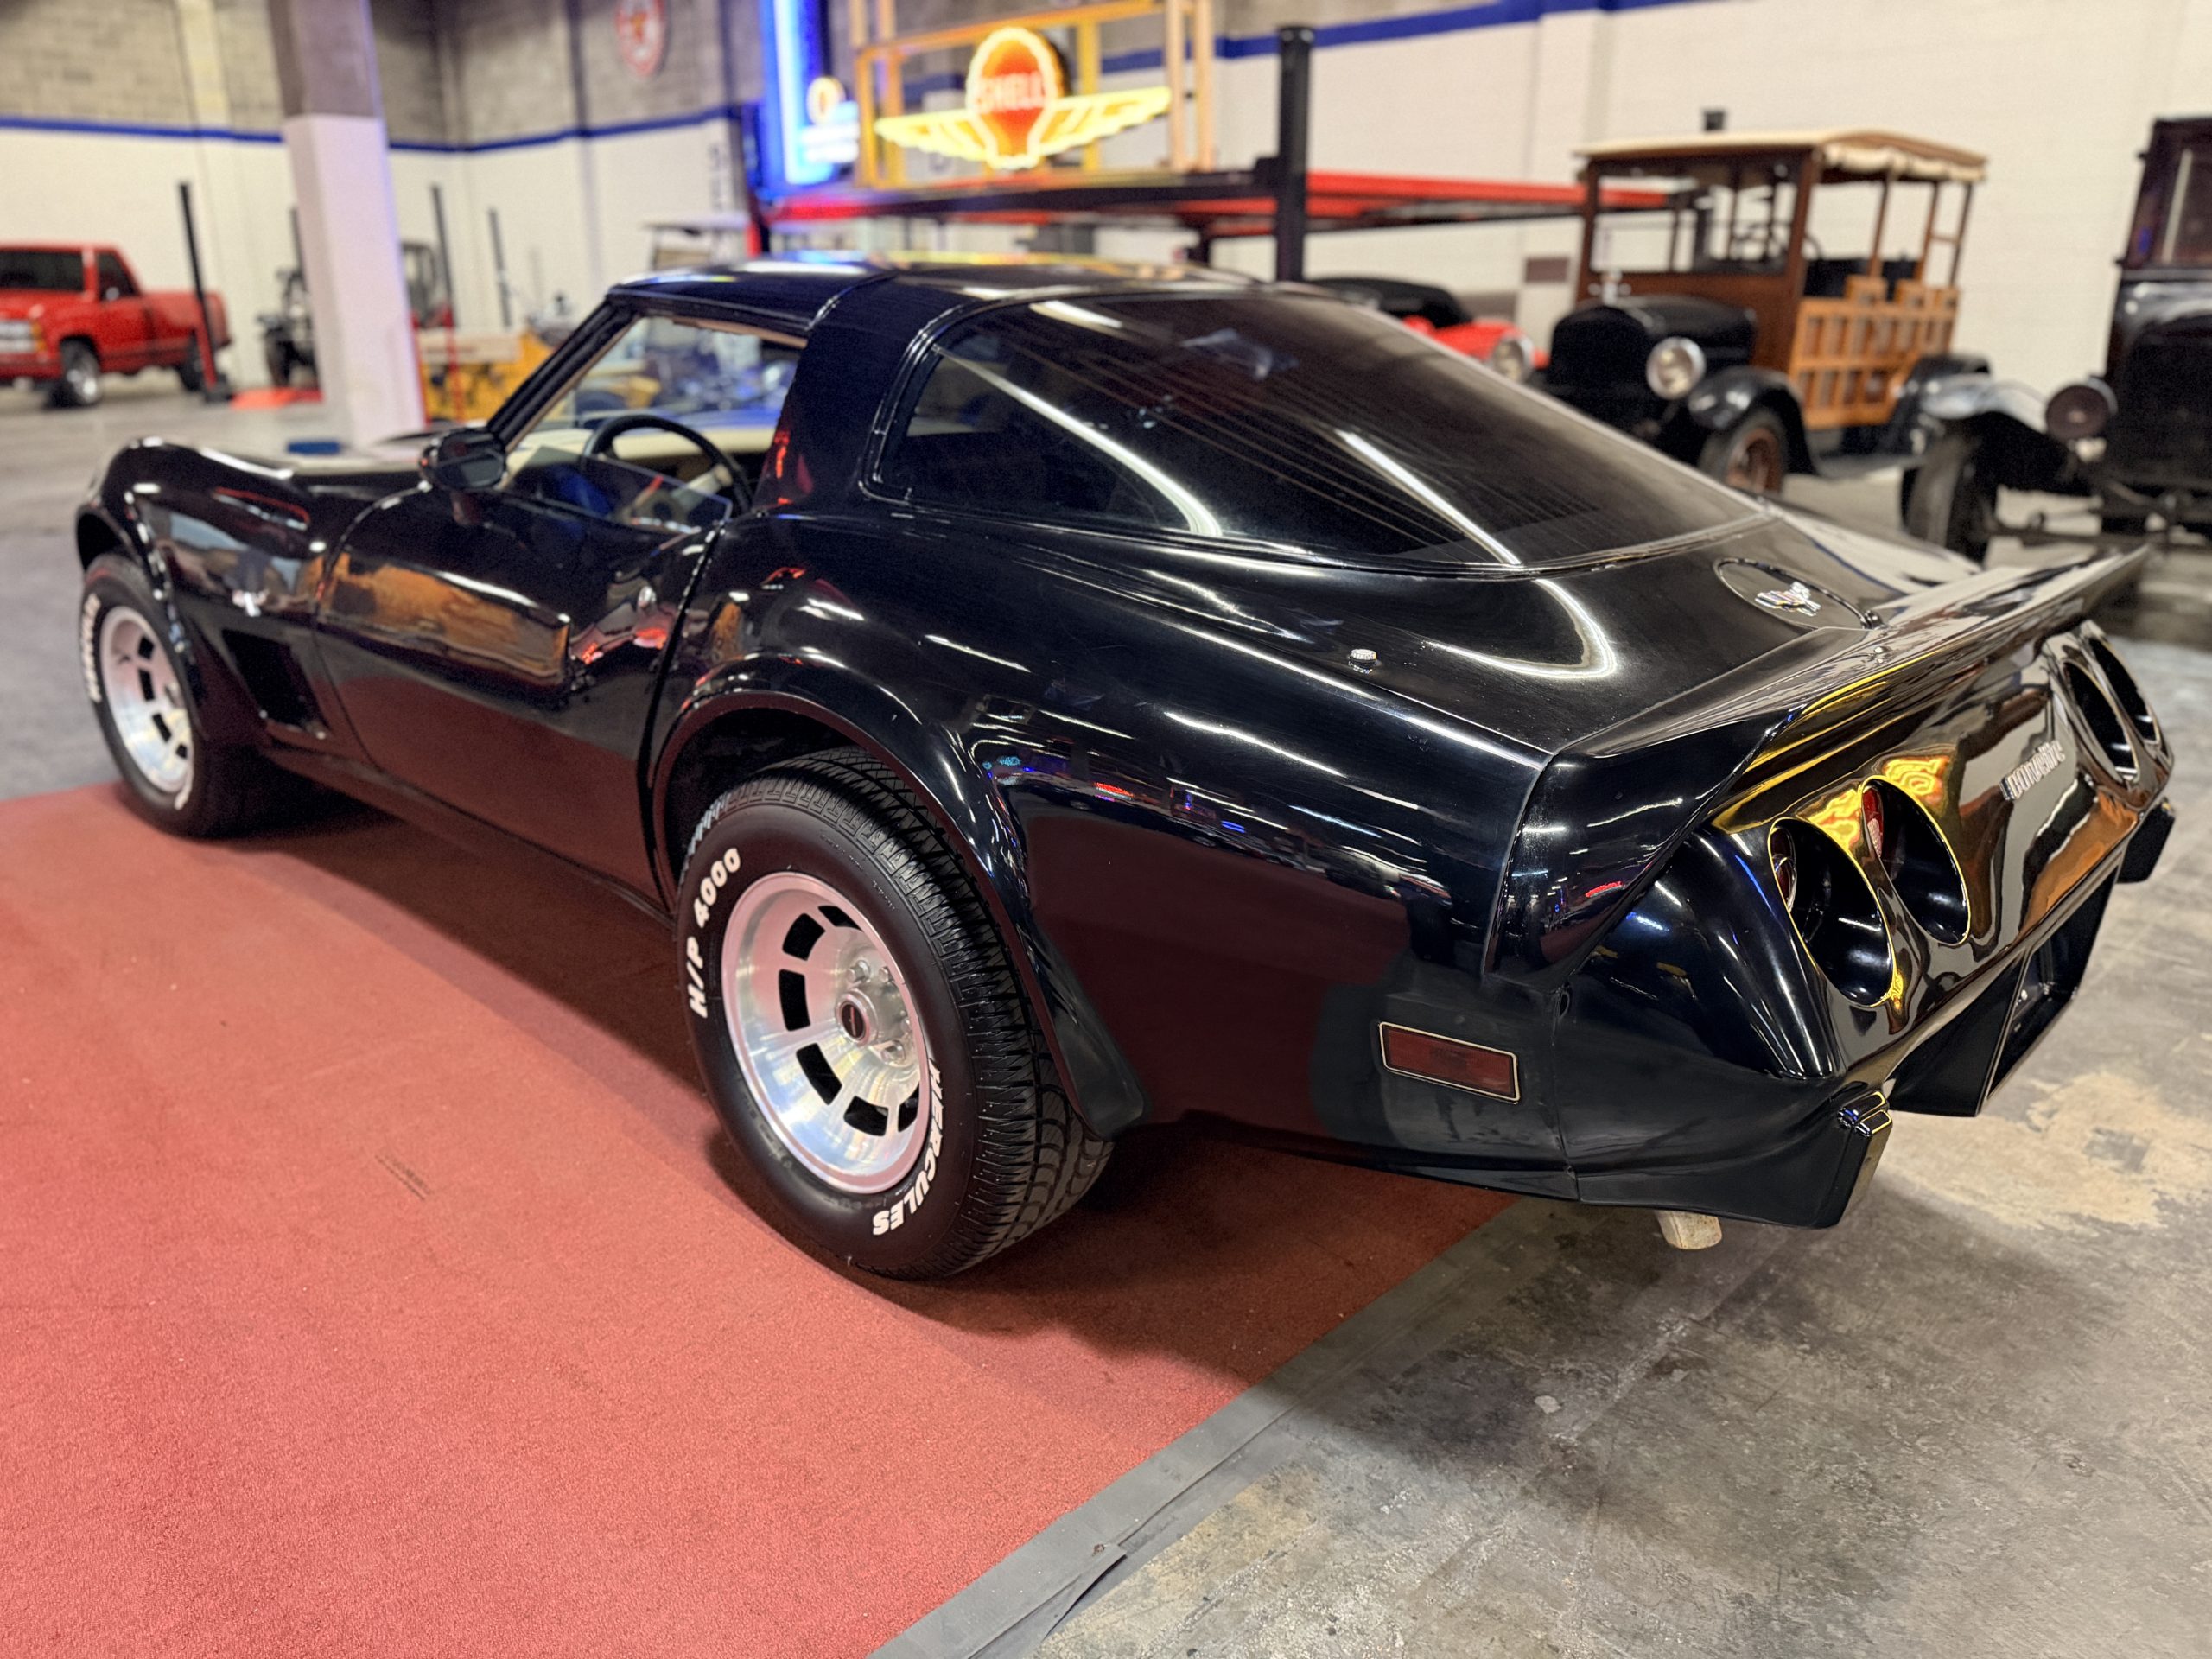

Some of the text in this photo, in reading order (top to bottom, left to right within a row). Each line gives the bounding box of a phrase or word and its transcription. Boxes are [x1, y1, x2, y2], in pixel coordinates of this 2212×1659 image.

[976, 71, 1046, 115] SHELL
[686, 848, 741, 1019] H/P 4000
[872, 1057, 944, 1236] HERCULES
